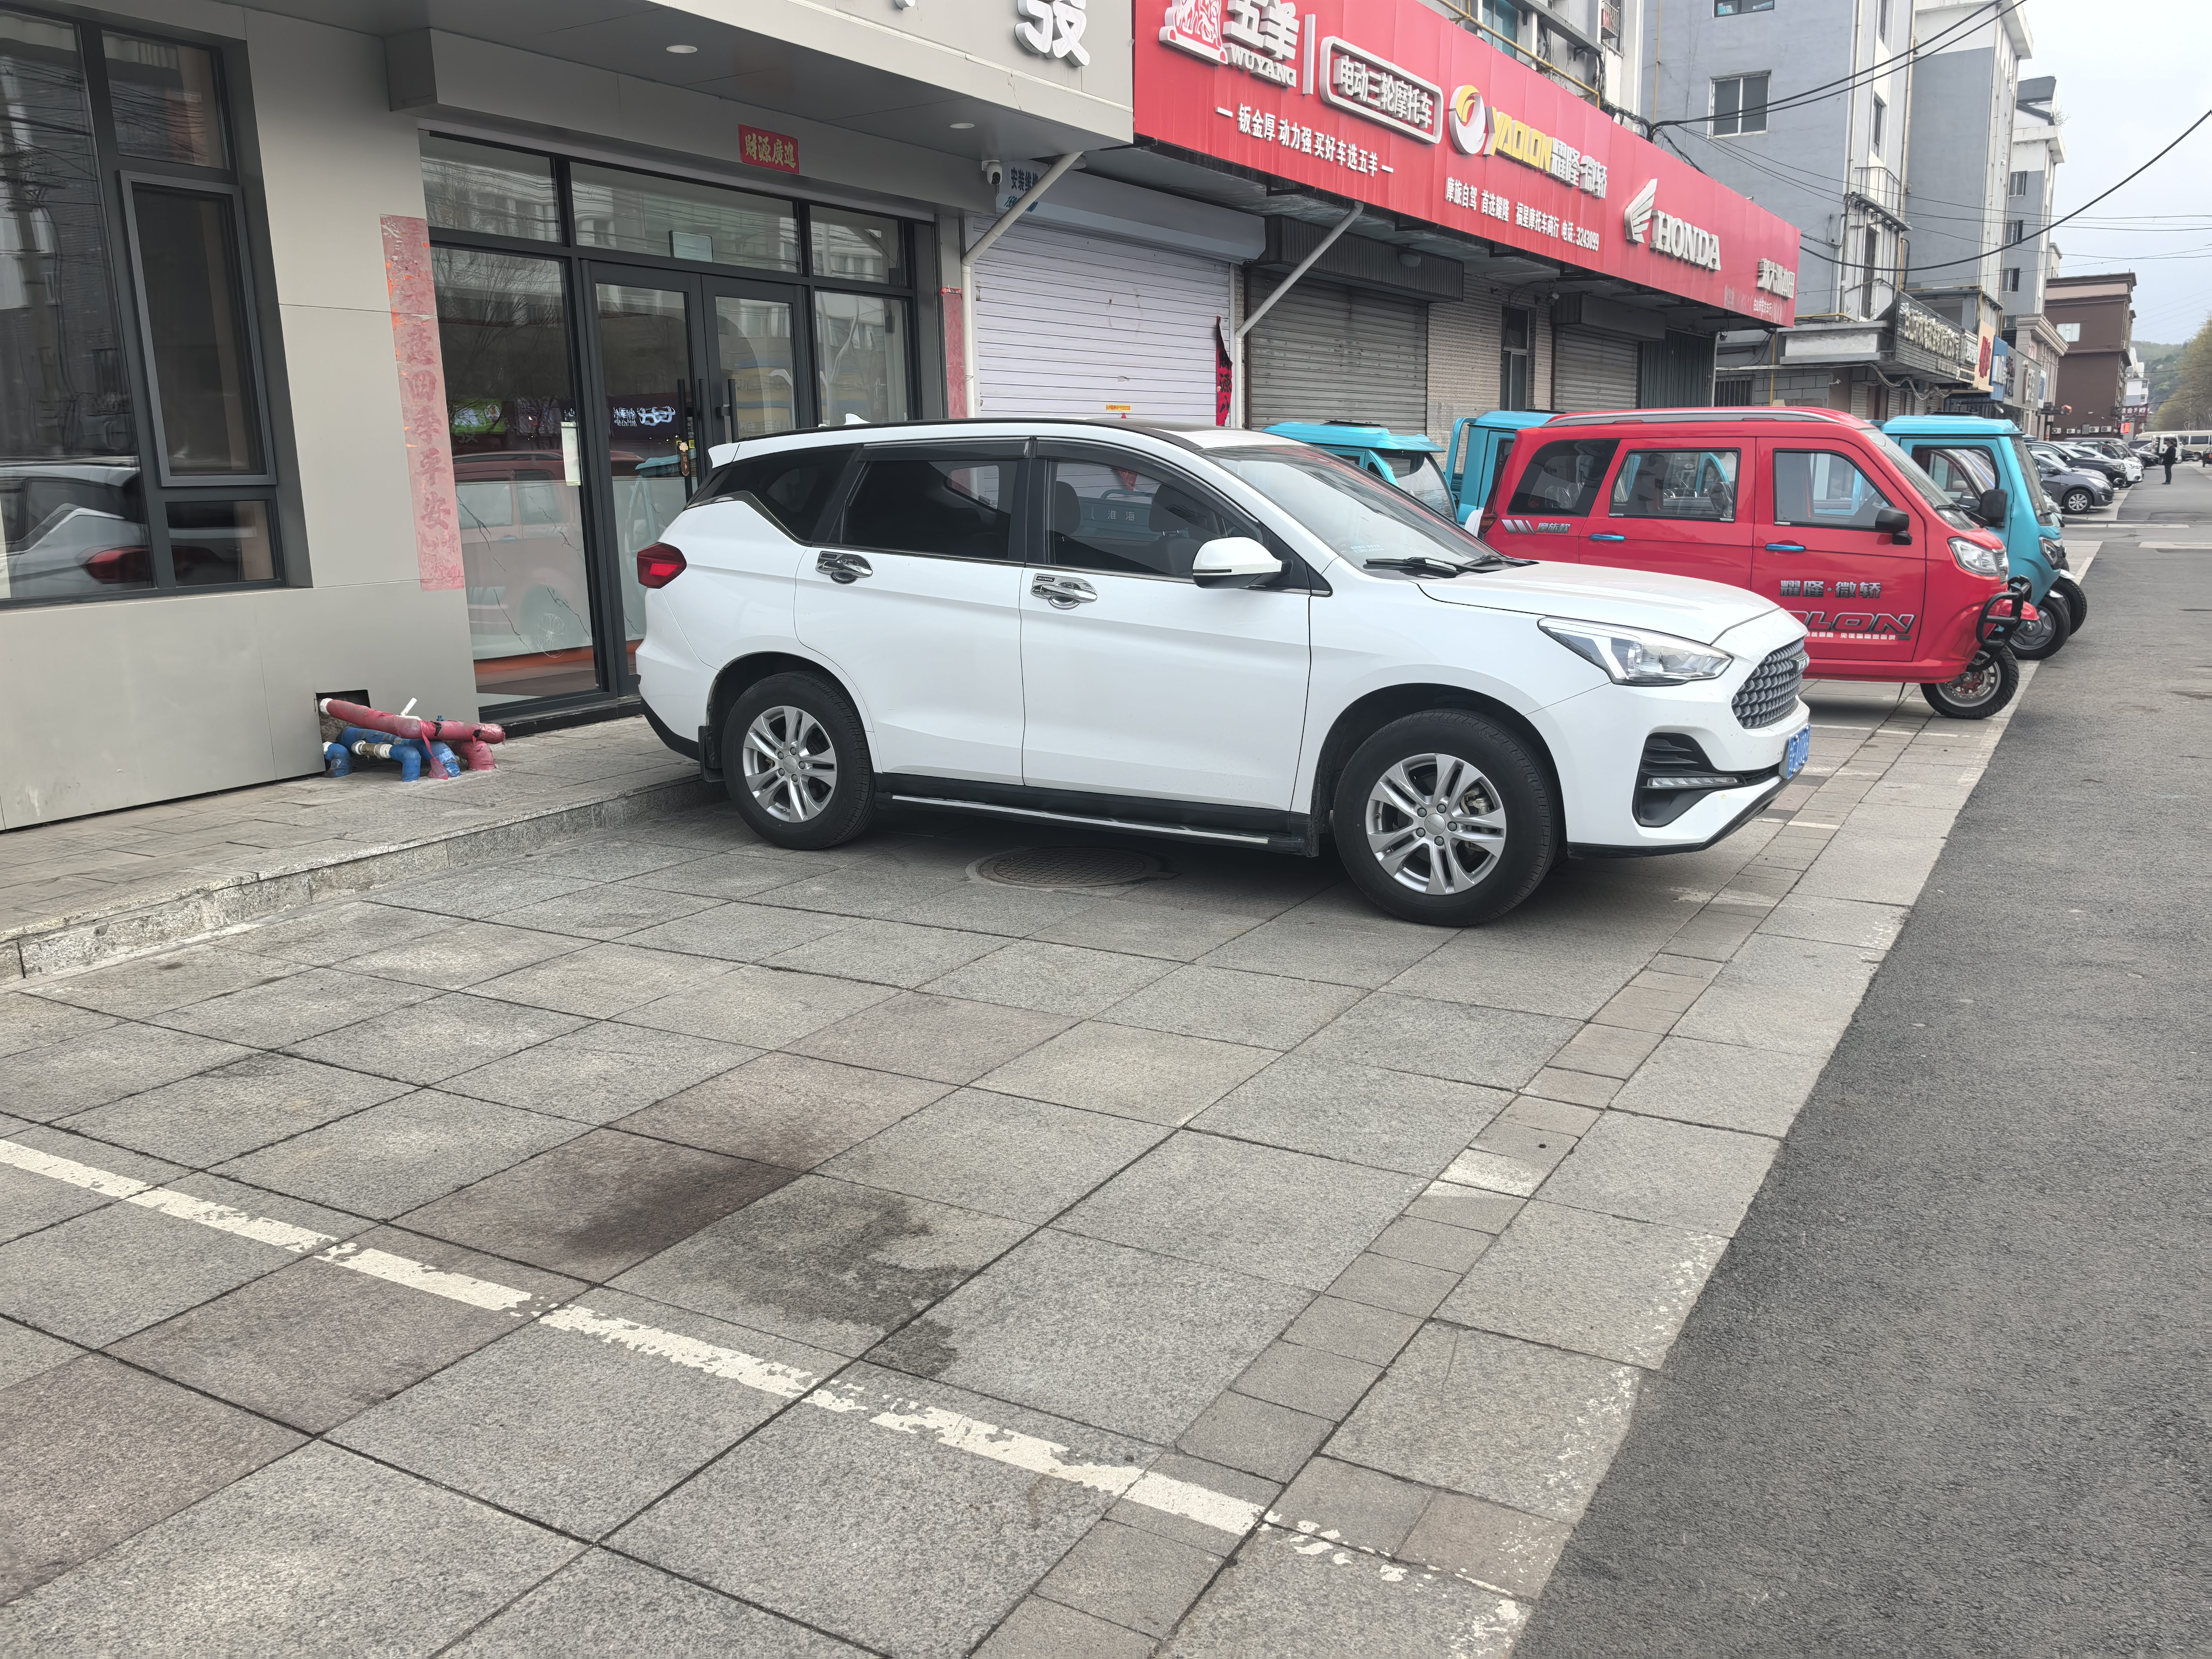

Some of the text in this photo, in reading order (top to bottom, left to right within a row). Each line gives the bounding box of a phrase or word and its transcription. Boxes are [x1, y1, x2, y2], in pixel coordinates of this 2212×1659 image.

[1223, 43, 1297, 88] WUYANG
[1334, 55, 1433, 128] 电动三轮摩托车
[1238, 103, 1378, 177] 钣金厚 动力强 买好车选五羊
[1483, 106, 1553, 172] YAOLON
[1445, 176, 1477, 211] 摩旅自驾
[1481, 190, 1509, 222] 首选耀隆
[1515, 201, 1559, 238] 福星摩托车商行
[1650, 210, 1721, 271] HONDA
[1780, 580, 1881, 598] 耀隆·微轿
